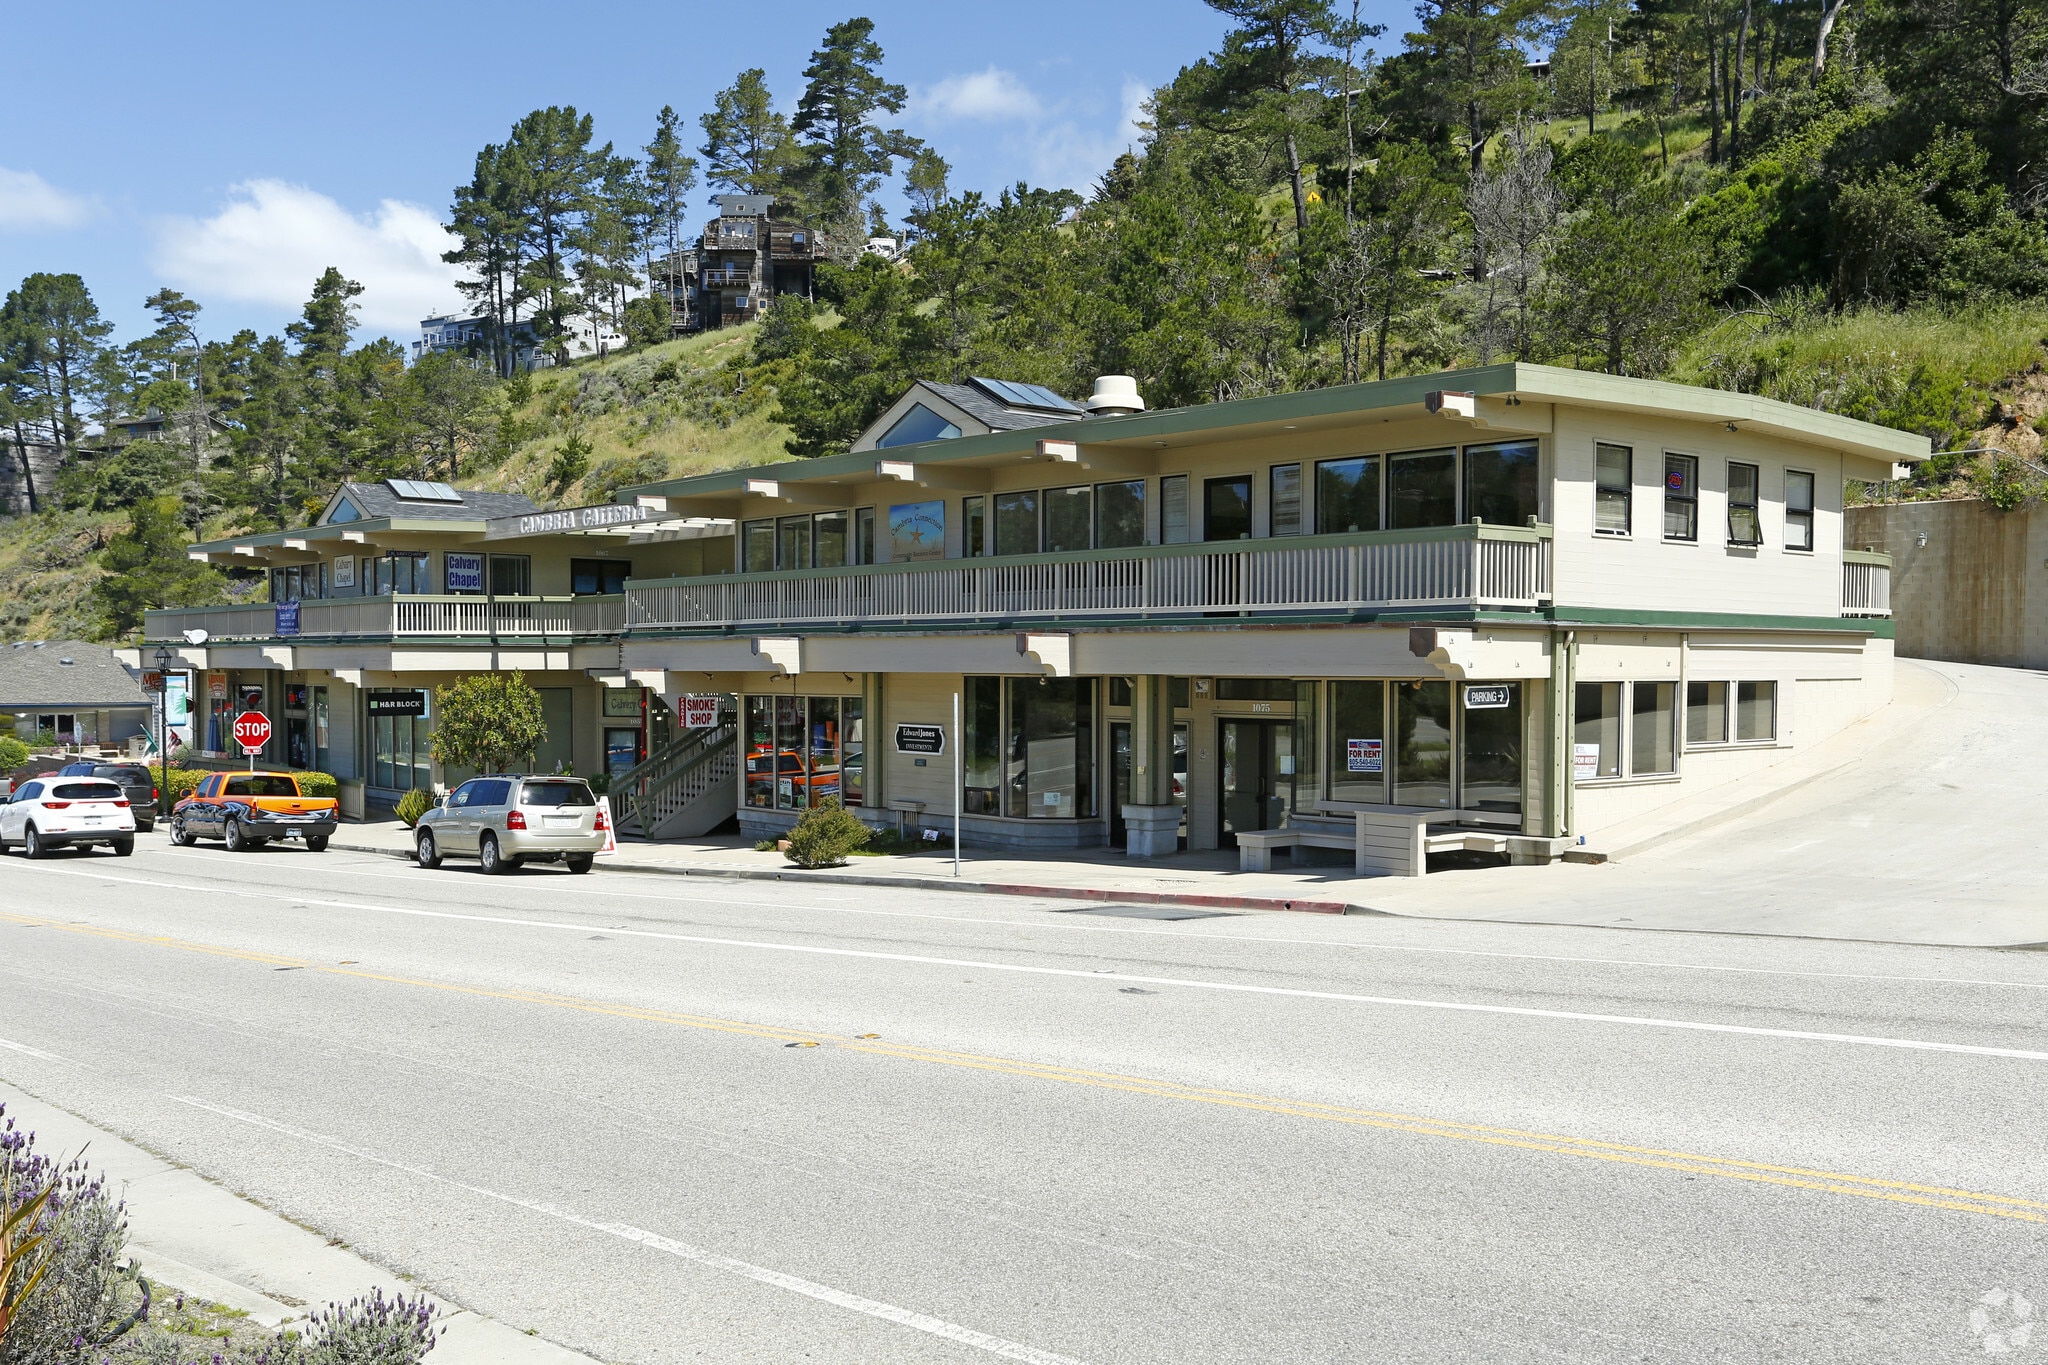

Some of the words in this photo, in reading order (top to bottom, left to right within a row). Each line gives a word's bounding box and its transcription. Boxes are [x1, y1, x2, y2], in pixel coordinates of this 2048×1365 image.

[520, 511, 576, 534] CAMBRIA
[582, 505, 646, 526] GALLERIA
[891, 517, 913, 536] Cambria
[914, 513, 943, 532] Connection
[449, 556, 480, 571] Calvary
[449, 572, 480, 587] Chapel
[1471, 691, 1497, 703] PARKING
[687, 699, 715, 711] SMOKE
[1252, 703, 1271, 713] 1075
[690, 712, 712, 725] SHOP
[236, 722, 269, 737] STOP
[1349, 750, 1362, 758] FOR
[1364, 750, 1381, 758] RENT
